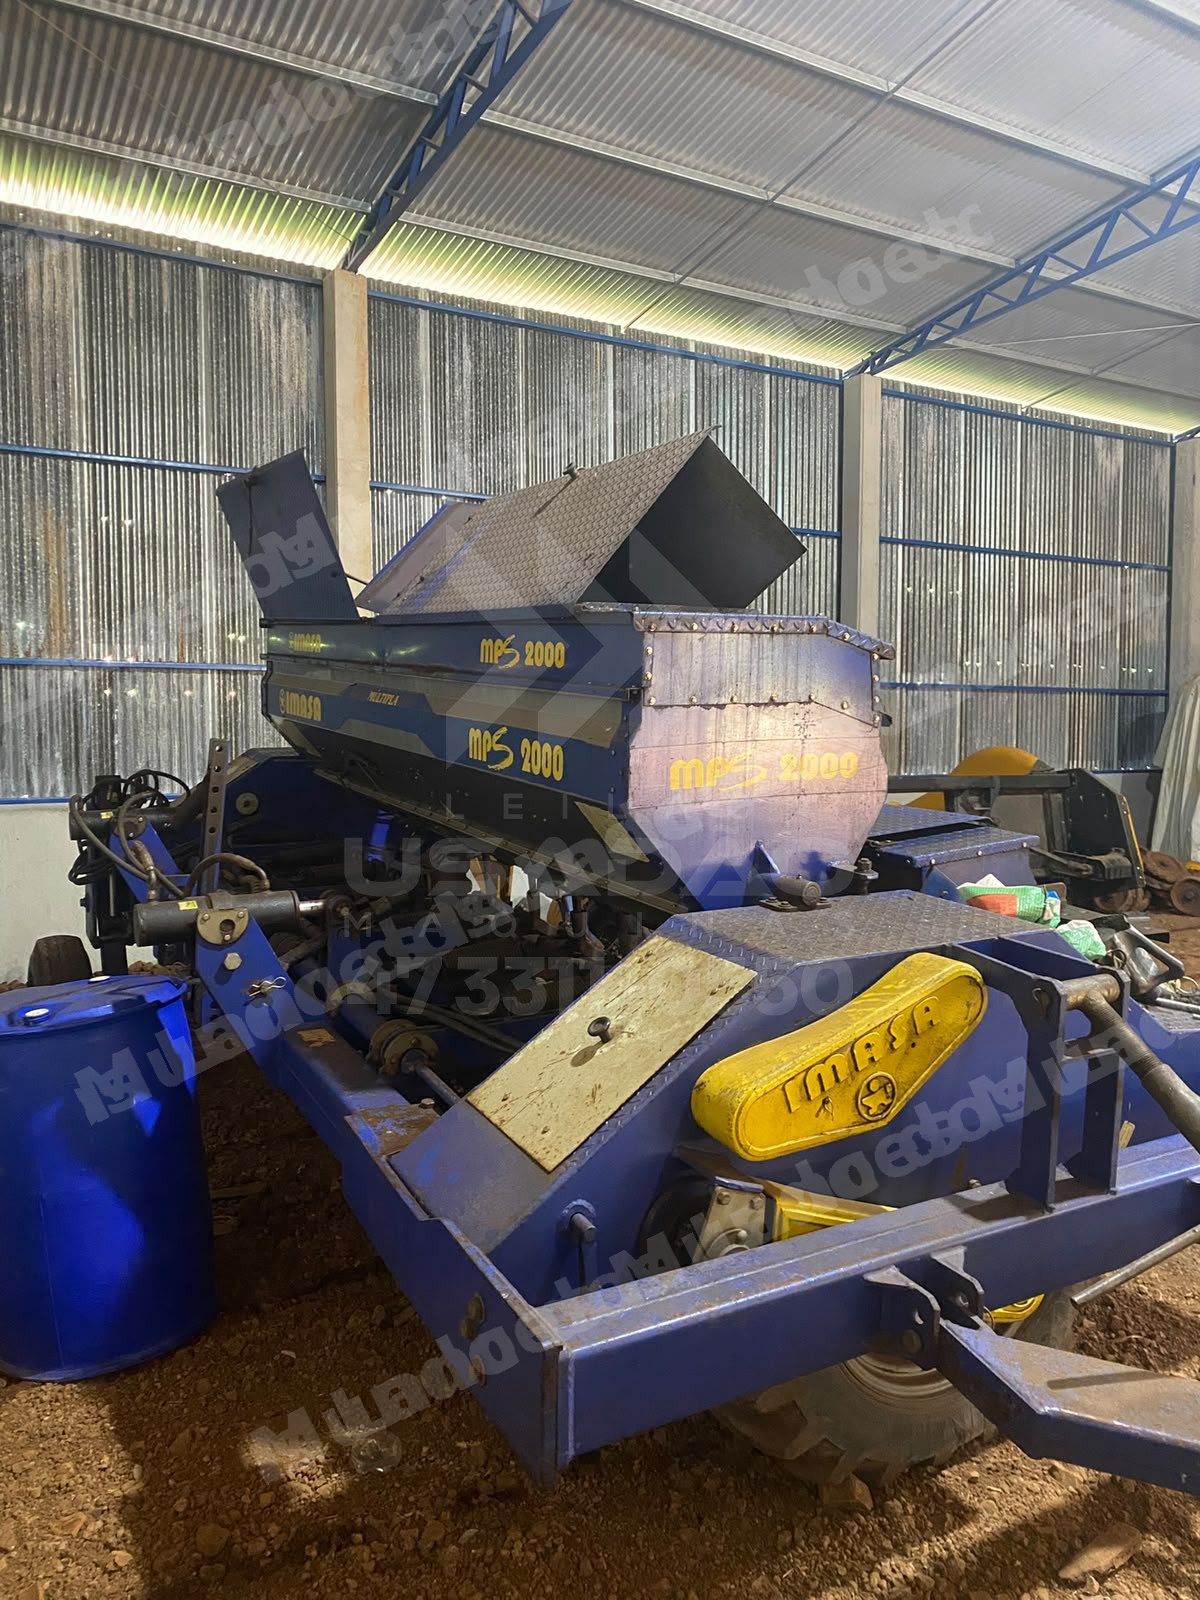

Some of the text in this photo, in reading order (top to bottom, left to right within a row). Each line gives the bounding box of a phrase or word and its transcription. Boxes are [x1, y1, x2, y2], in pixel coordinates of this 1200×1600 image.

[480, 634, 565, 669] MPS 2000
[286, 690, 322, 721] IMASA
[468, 726, 564, 781] MPS 2000
[779, 752, 858, 782] 2000
[783, 995, 940, 1114] IMASA
